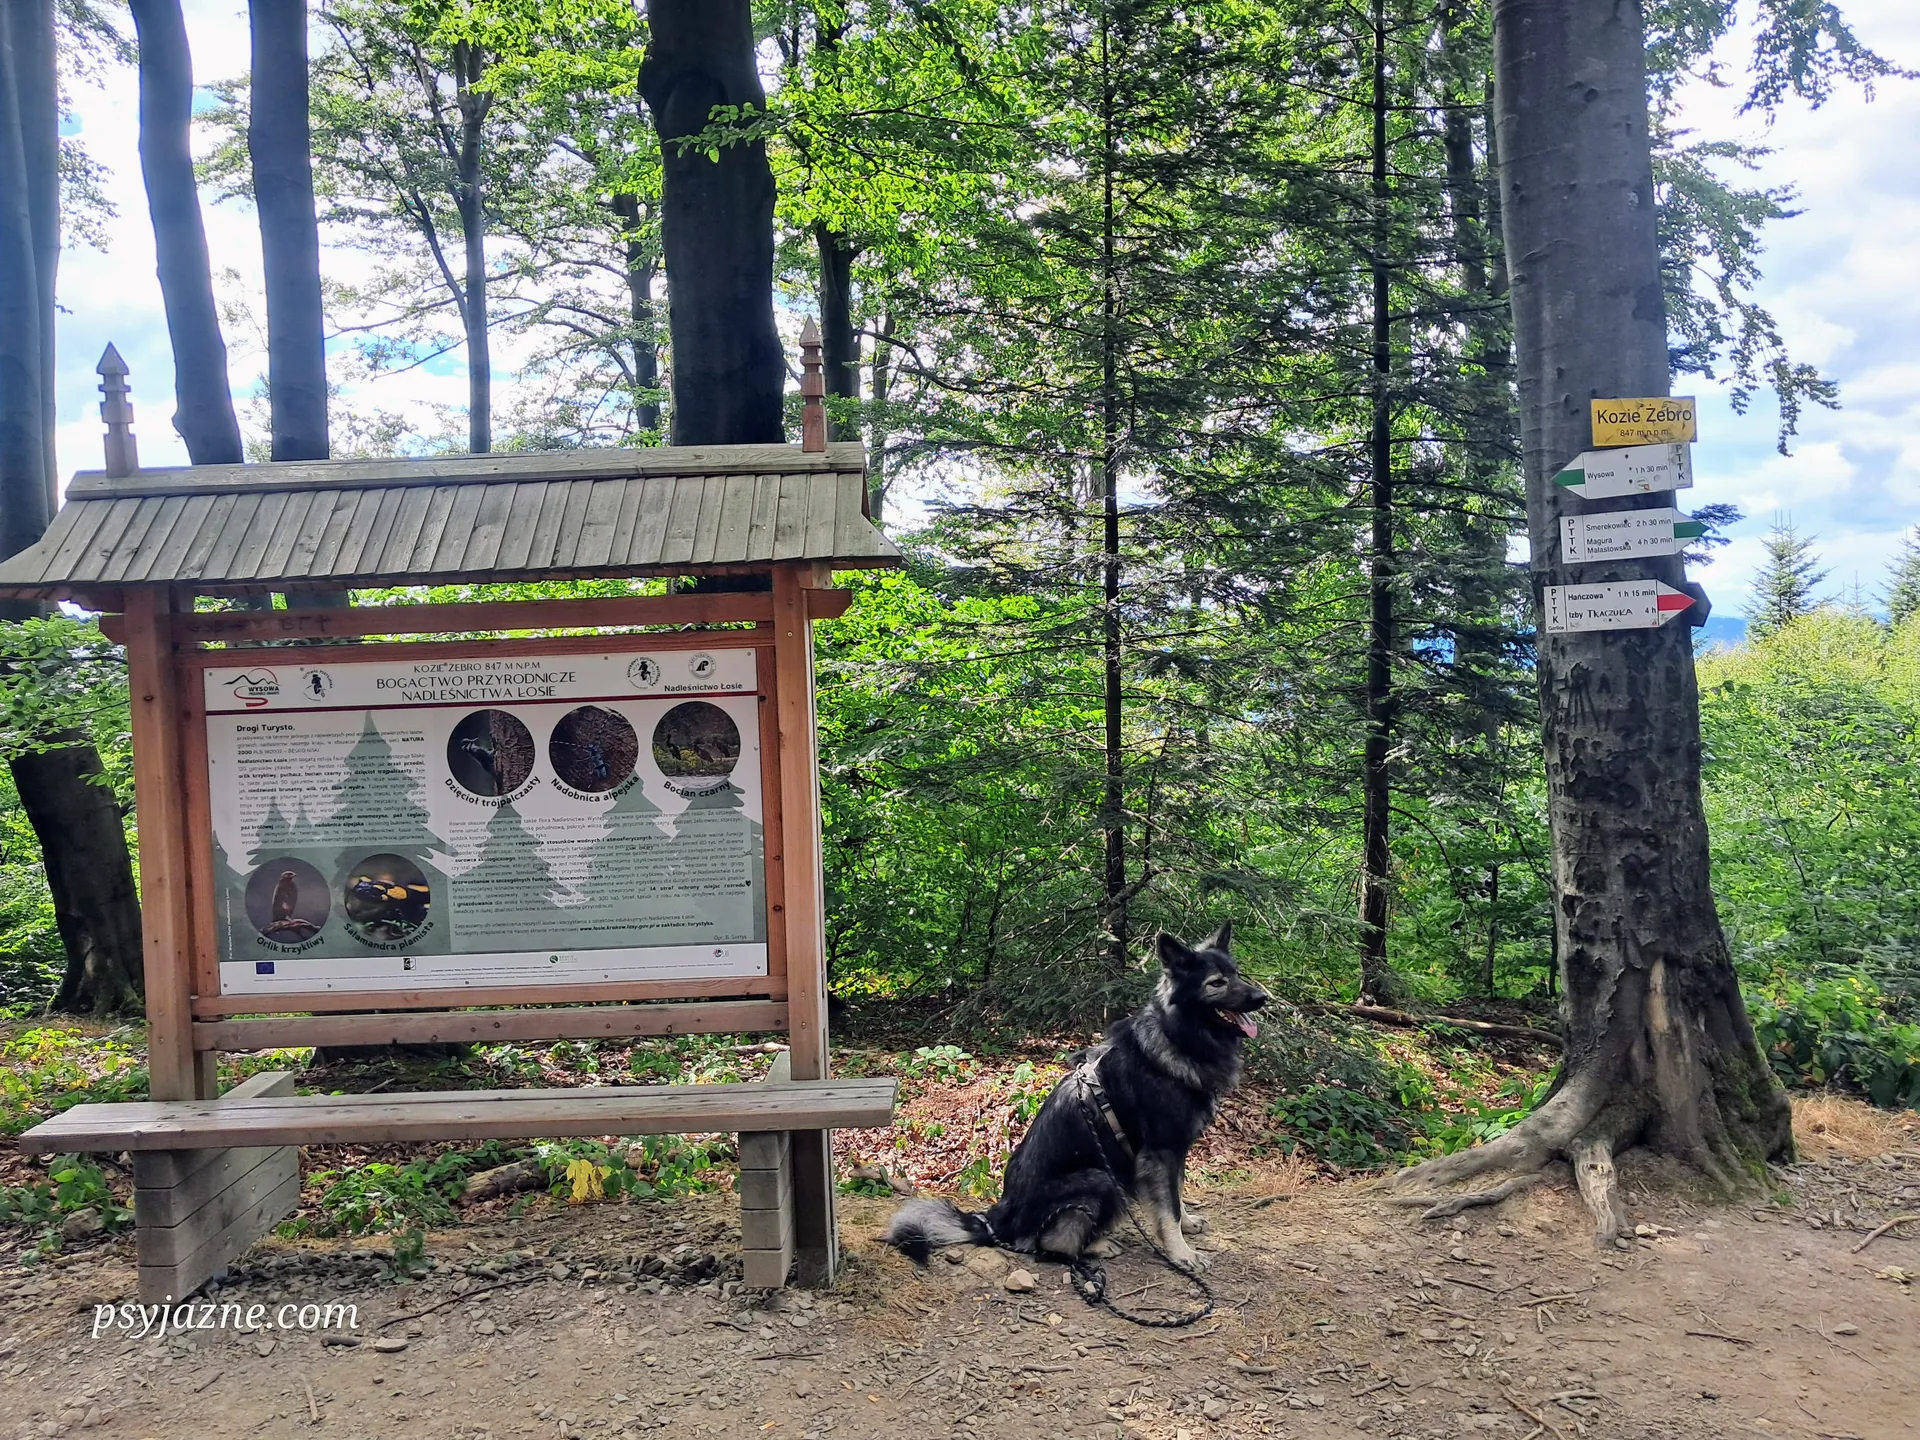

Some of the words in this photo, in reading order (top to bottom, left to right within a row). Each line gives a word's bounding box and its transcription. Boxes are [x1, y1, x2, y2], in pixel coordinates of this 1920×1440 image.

[1597, 408, 1641, 424] Kozie
[1645, 403, 1692, 422] Żebro
[1620, 429, 1635, 437] 847
[1675, 444, 1685, 481] PTTK
[1586, 471, 1615, 481] Wysowa
[1646, 465, 1655, 473] 30
[1656, 464, 1668, 472] min
[1586, 521, 1632, 532] Smerekowiec
[1648, 518, 1657, 526] 30
[1658, 517, 1671, 525] min
[1567, 518, 1578, 555] PTTK
[1586, 537, 1613, 546] Magura
[1649, 537, 1659, 545] 30
[1659, 536, 1673, 544] min
[1568, 592, 1604, 601] Hańczowa
[1641, 588, 1656, 596] min
[1550, 588, 1559, 624] PTTK
[1569, 611, 1583, 620] Izby
[1651, 606, 1657, 614] h
[413, 664, 444, 673] KOZIE
[485, 661, 502, 671] 847
[504, 662, 513, 670] M
[376, 675, 463, 690] BOGACTWO
[467, 671, 577, 686] PRZYRODNICZE
[664, 684, 719, 693] Nadleśnictwo
[720, 682, 743, 691] Łosie
[401, 686, 513, 702] NADLEŚNICTWA
[517, 686, 556, 697] ŁOSIE
[236, 724, 259, 734] Drogi
[444, 777, 480, 805] Dzięcioł
[482, 775, 541, 808] trójpalczasty
[550, 778, 601, 803] Nadobnica
[603, 775, 640, 801] alpejska
[663, 780, 696, 798] Bocian
[698, 780, 732, 798] czarny
[256, 936, 279, 952] Orlik
[281, 934, 325, 954] krzykliwy
[342, 923, 396, 951] Salamandra
[398, 921, 435, 951] plamista
